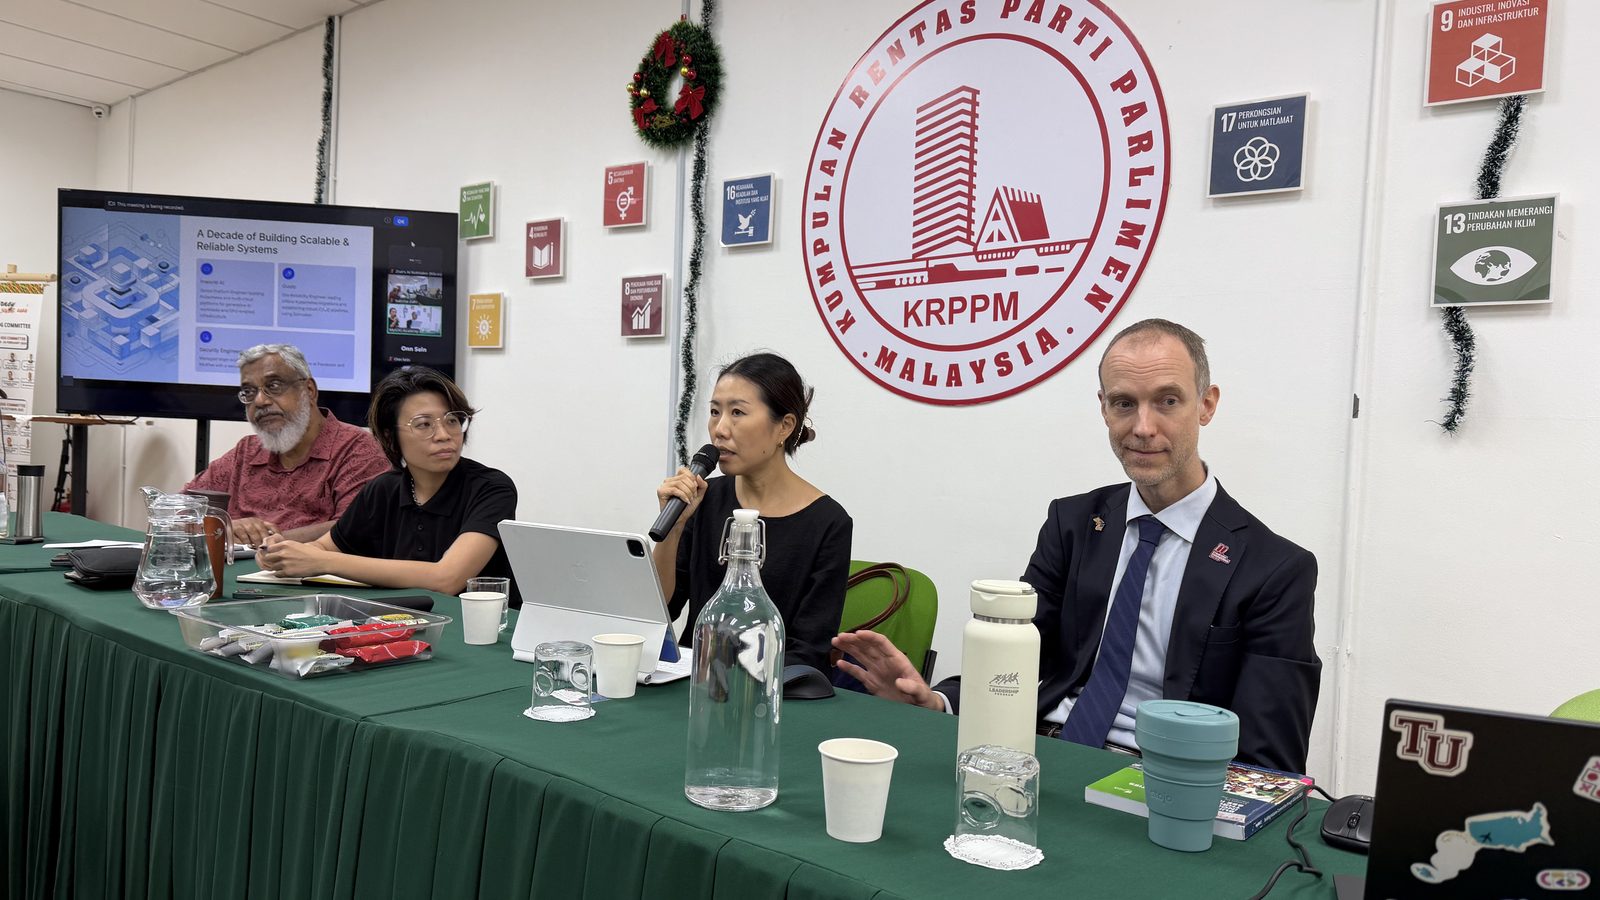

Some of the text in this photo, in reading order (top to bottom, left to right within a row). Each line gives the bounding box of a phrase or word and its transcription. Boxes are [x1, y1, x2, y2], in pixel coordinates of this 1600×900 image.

[1458, 0, 1530, 17] INDUSTRI, INOVASI
[1440, 10, 1454, 32] 9
[1457, 7, 1539, 29] DAN INFRASTRUKTUR
[1238, 106, 1282, 120] PERKONGSIAN
[1221, 112, 1236, 133] 17
[1237, 115, 1294, 130] UNTUK MATLAMAT
[812, 0, 1155, 335] KUMPULAN RENTAS PARTI PARLIMEN
[607, 171, 613, 185] 5
[462, 190, 467, 203] 3
[726, 185, 736, 200] 16
[1467, 205, 1553, 221] TINDAKAN MEMERANGI
[1443, 212, 1466, 235] 13
[1466, 218, 1536, 232] PERUBAHAN IKLIM
[196, 229, 350, 247] A Decade of Building Scalable &
[528, 226, 534, 240] 4
[196, 241, 279, 255] Reliable Systems
[624, 281, 631, 296] 8
[472, 298, 477, 311] 7
[902, 291, 1019, 328] KRPPM
[874, 326, 1060, 388] MALAYSIA
[1394, 714, 1468, 773] TU
